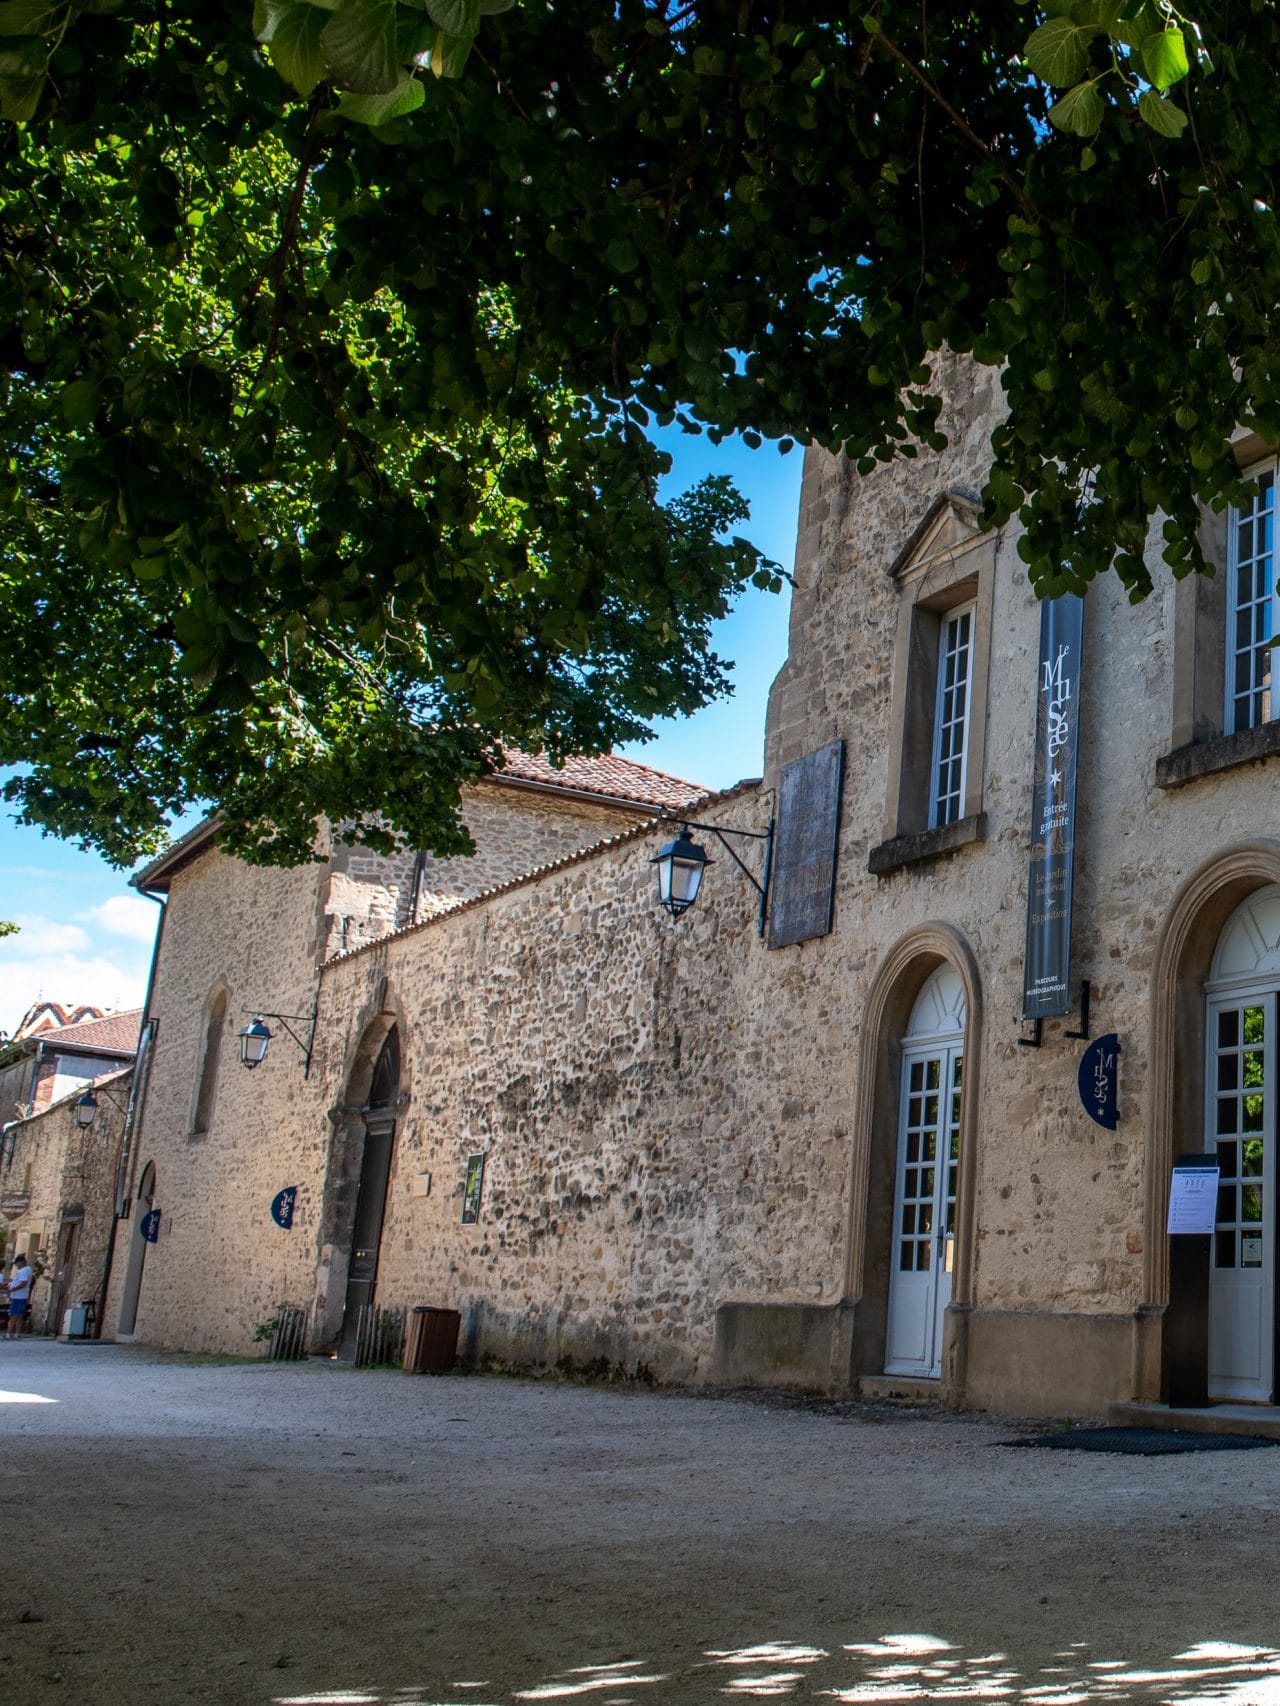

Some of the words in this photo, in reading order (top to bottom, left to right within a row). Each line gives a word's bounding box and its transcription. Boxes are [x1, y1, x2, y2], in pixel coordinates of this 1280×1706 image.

[1059, 644, 1070, 658] Le
[1041, 656, 1071, 758] Musée
[1043, 801, 1068, 818] Entrée
[1039, 816, 1069, 835] gratuite
